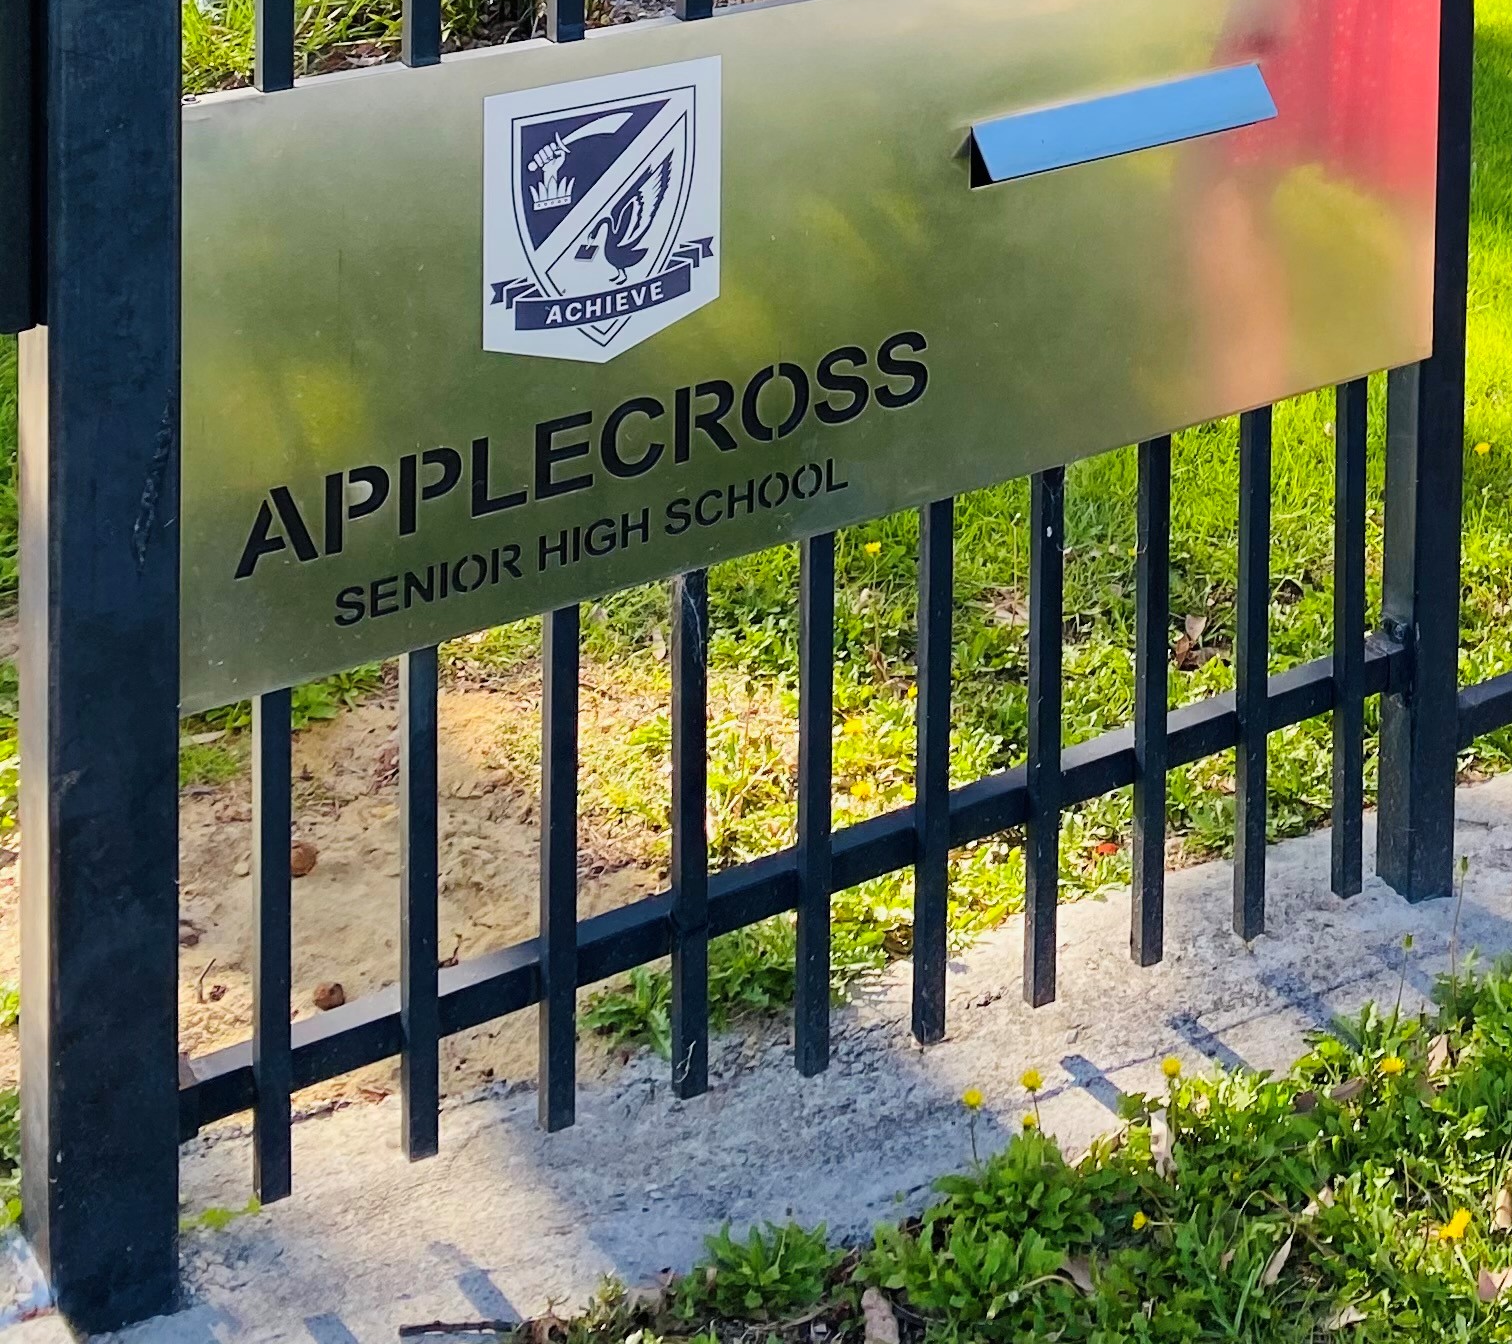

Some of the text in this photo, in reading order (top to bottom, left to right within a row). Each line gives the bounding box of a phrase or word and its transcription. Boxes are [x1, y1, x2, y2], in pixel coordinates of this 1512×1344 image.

[545, 280, 665, 325] ACHIEVE
[233, 331, 929, 580] APPLECROSS
[333, 458, 849, 626] SENIOR HIGH SCHOOL
